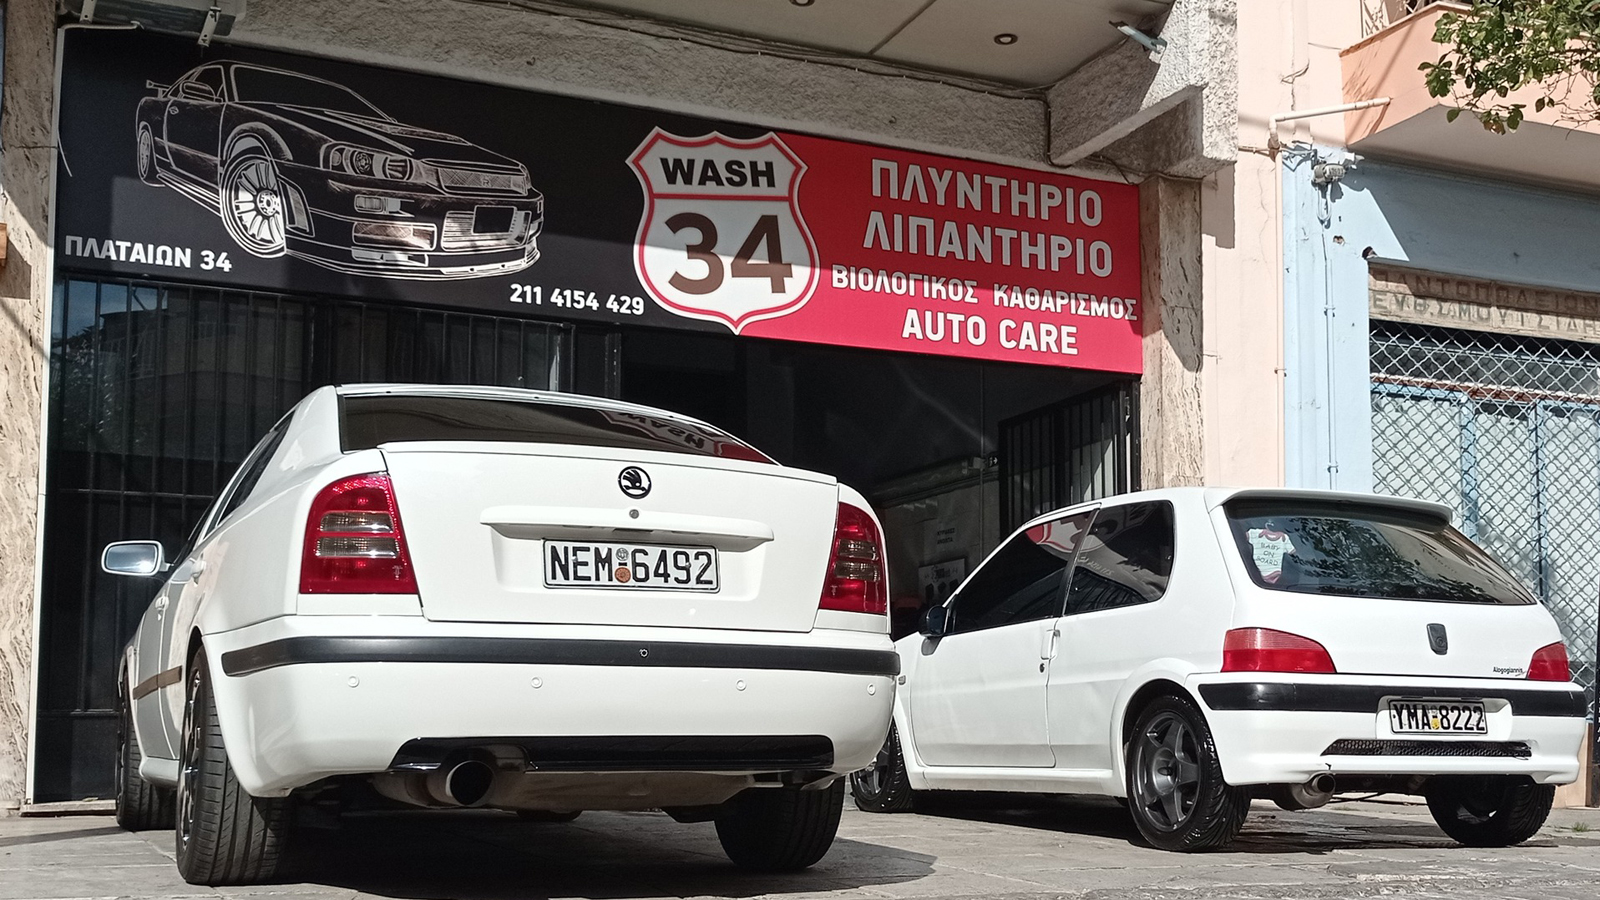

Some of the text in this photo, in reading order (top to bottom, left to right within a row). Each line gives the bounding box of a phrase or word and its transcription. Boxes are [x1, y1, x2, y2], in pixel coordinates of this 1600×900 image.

[659, 157, 776, 188] WASH
[871, 158, 1103, 227] ΠΛΥΝΤΗΡΙΟ
[65, 235, 232, 272] ΠΛΑΤΑΙΩΝ 34
[664, 212, 794, 295] 34
[862, 210, 1113, 278] ΛΙΠΑΝΤΗΡΙΟ
[510, 283, 645, 315] 211 4154 429
[831, 264, 1138, 321] ΒΙΟΛΟΓΙΚΟΣ ΚΑΘΑΡΙΣΜΟΣ
[901, 308, 1078, 355] AUTO CARE
[1256, 555, 1279, 566] BOARD
[1260, 542, 1281, 551] BABY
[1263, 550, 1275, 558] ON
